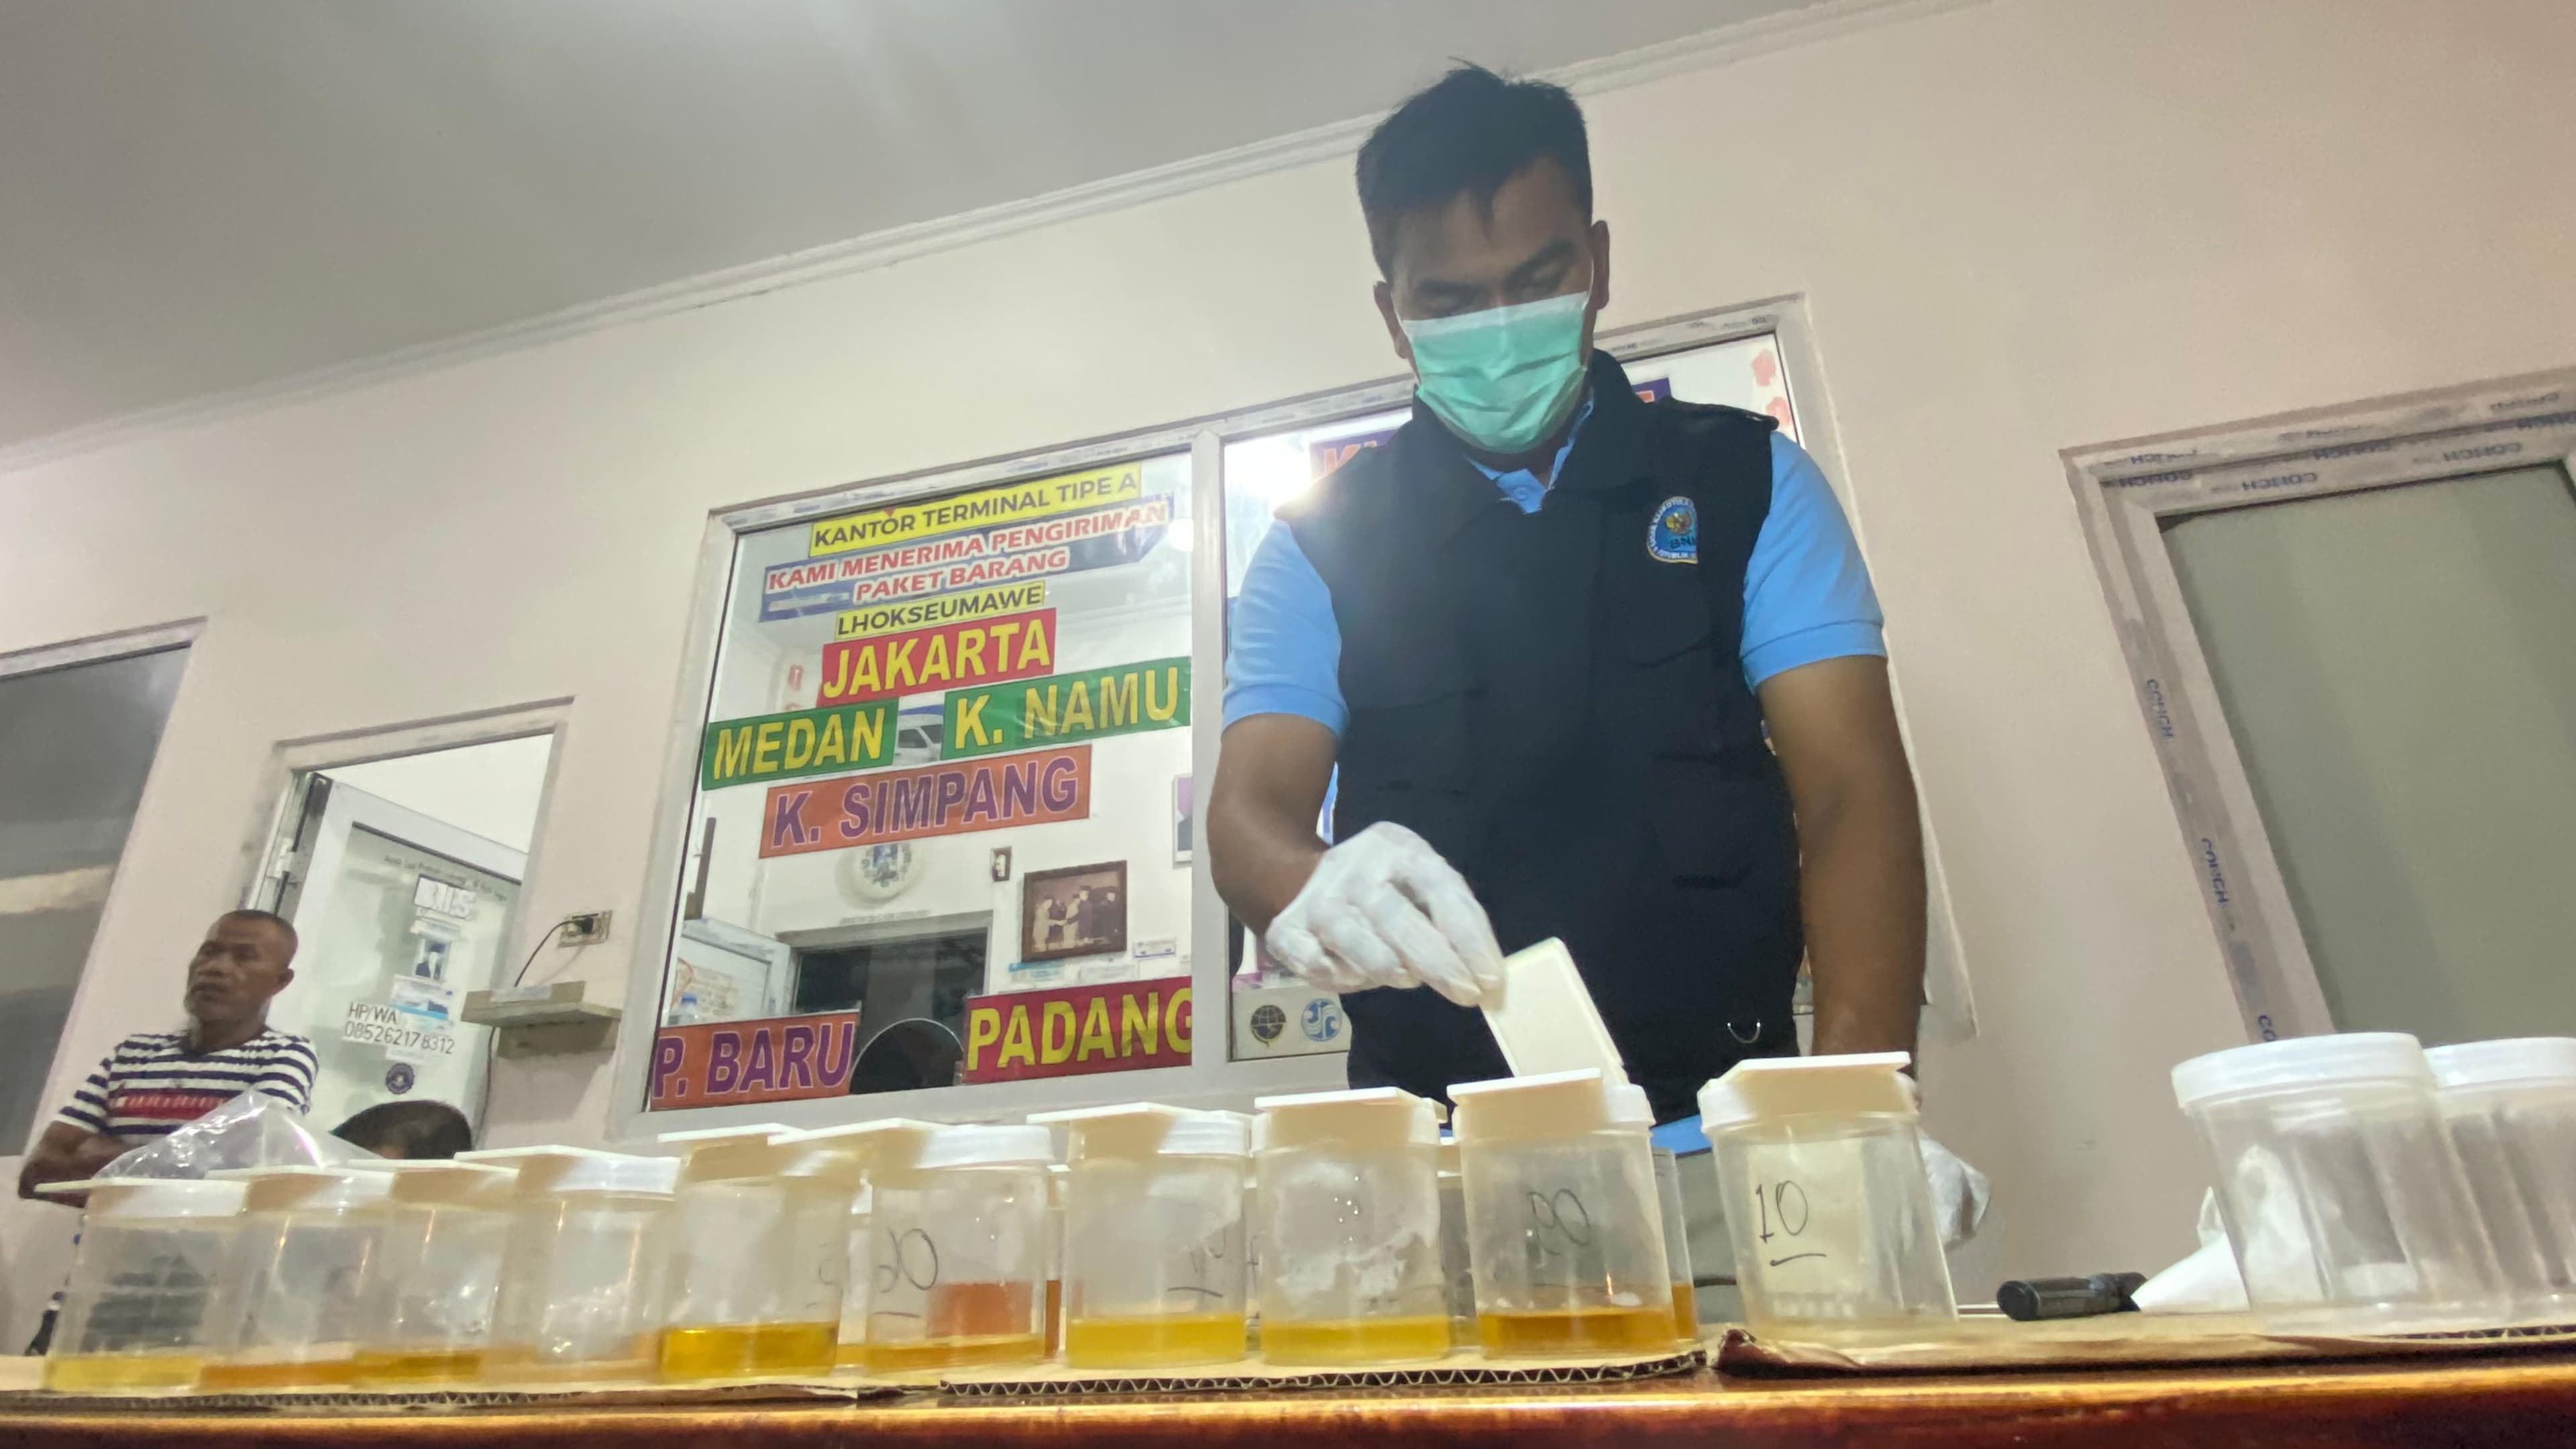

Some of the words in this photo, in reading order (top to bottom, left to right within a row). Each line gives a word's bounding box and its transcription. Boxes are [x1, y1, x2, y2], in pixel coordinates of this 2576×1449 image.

[767, 562, 837, 591] KAMI
[841, 537, 985, 578] MENERIMA
[991, 504, 1167, 552] PENGIRIMAN
[814, 513, 917, 549] KANTOR
[920, 492, 1051, 528] TERMINAL
[1056, 477, 1112, 506] TIPE
[1116, 474, 1138, 493] A
[837, 584, 1044, 635] LHOKSEUMAWE
[855, 571, 944, 602] PAKET
[948, 548, 1068, 586] BARANG
[822, 619, 1051, 699] JAKARTA
[712, 708, 885, 781] MEDAN
[954, 694, 1003, 751] K.
[1024, 666, 1179, 739] NAMU
[771, 790, 818, 848] K.
[839, 757, 1077, 839] SIMPANG
[348, 1001, 397, 1025] HP/WA
[966, 987, 1193, 1073] PADANG
[652, 1036, 687, 1099] P.
[706, 1021, 855, 1095] BARU
[1756, 1180, 1809, 1244] 10
